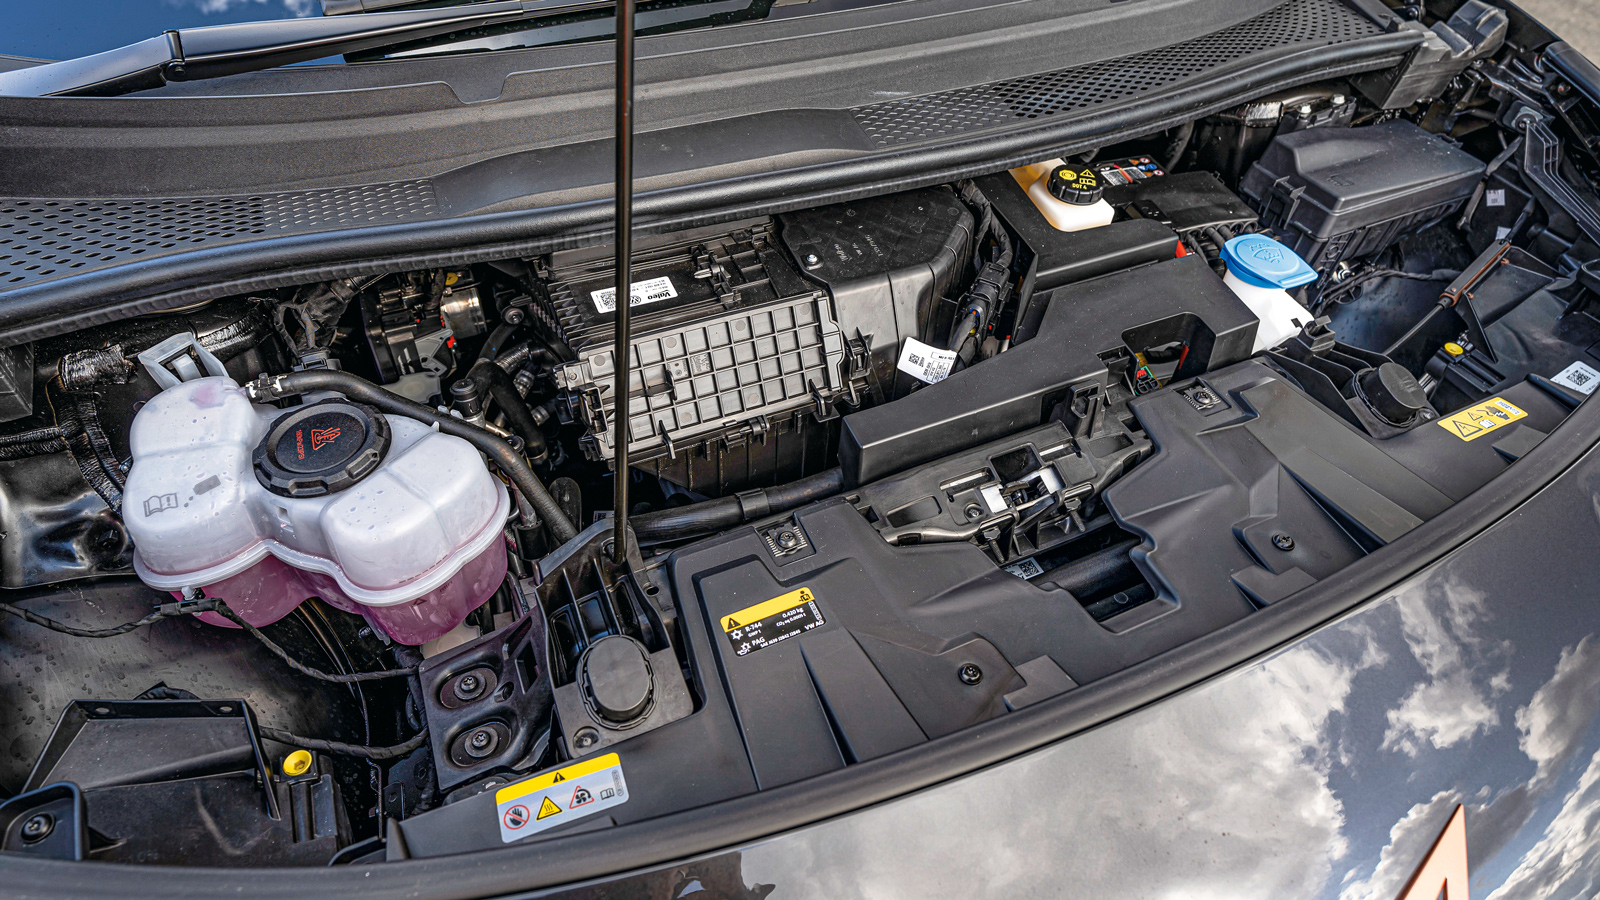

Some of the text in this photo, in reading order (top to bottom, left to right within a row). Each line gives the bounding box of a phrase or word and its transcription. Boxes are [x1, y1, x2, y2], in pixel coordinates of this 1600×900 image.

[648, 290, 671, 300] Valeo
[782, 610, 796, 618] 0.420
[745, 622, 762, 632] R-744
[752, 637, 765, 646] PAG
